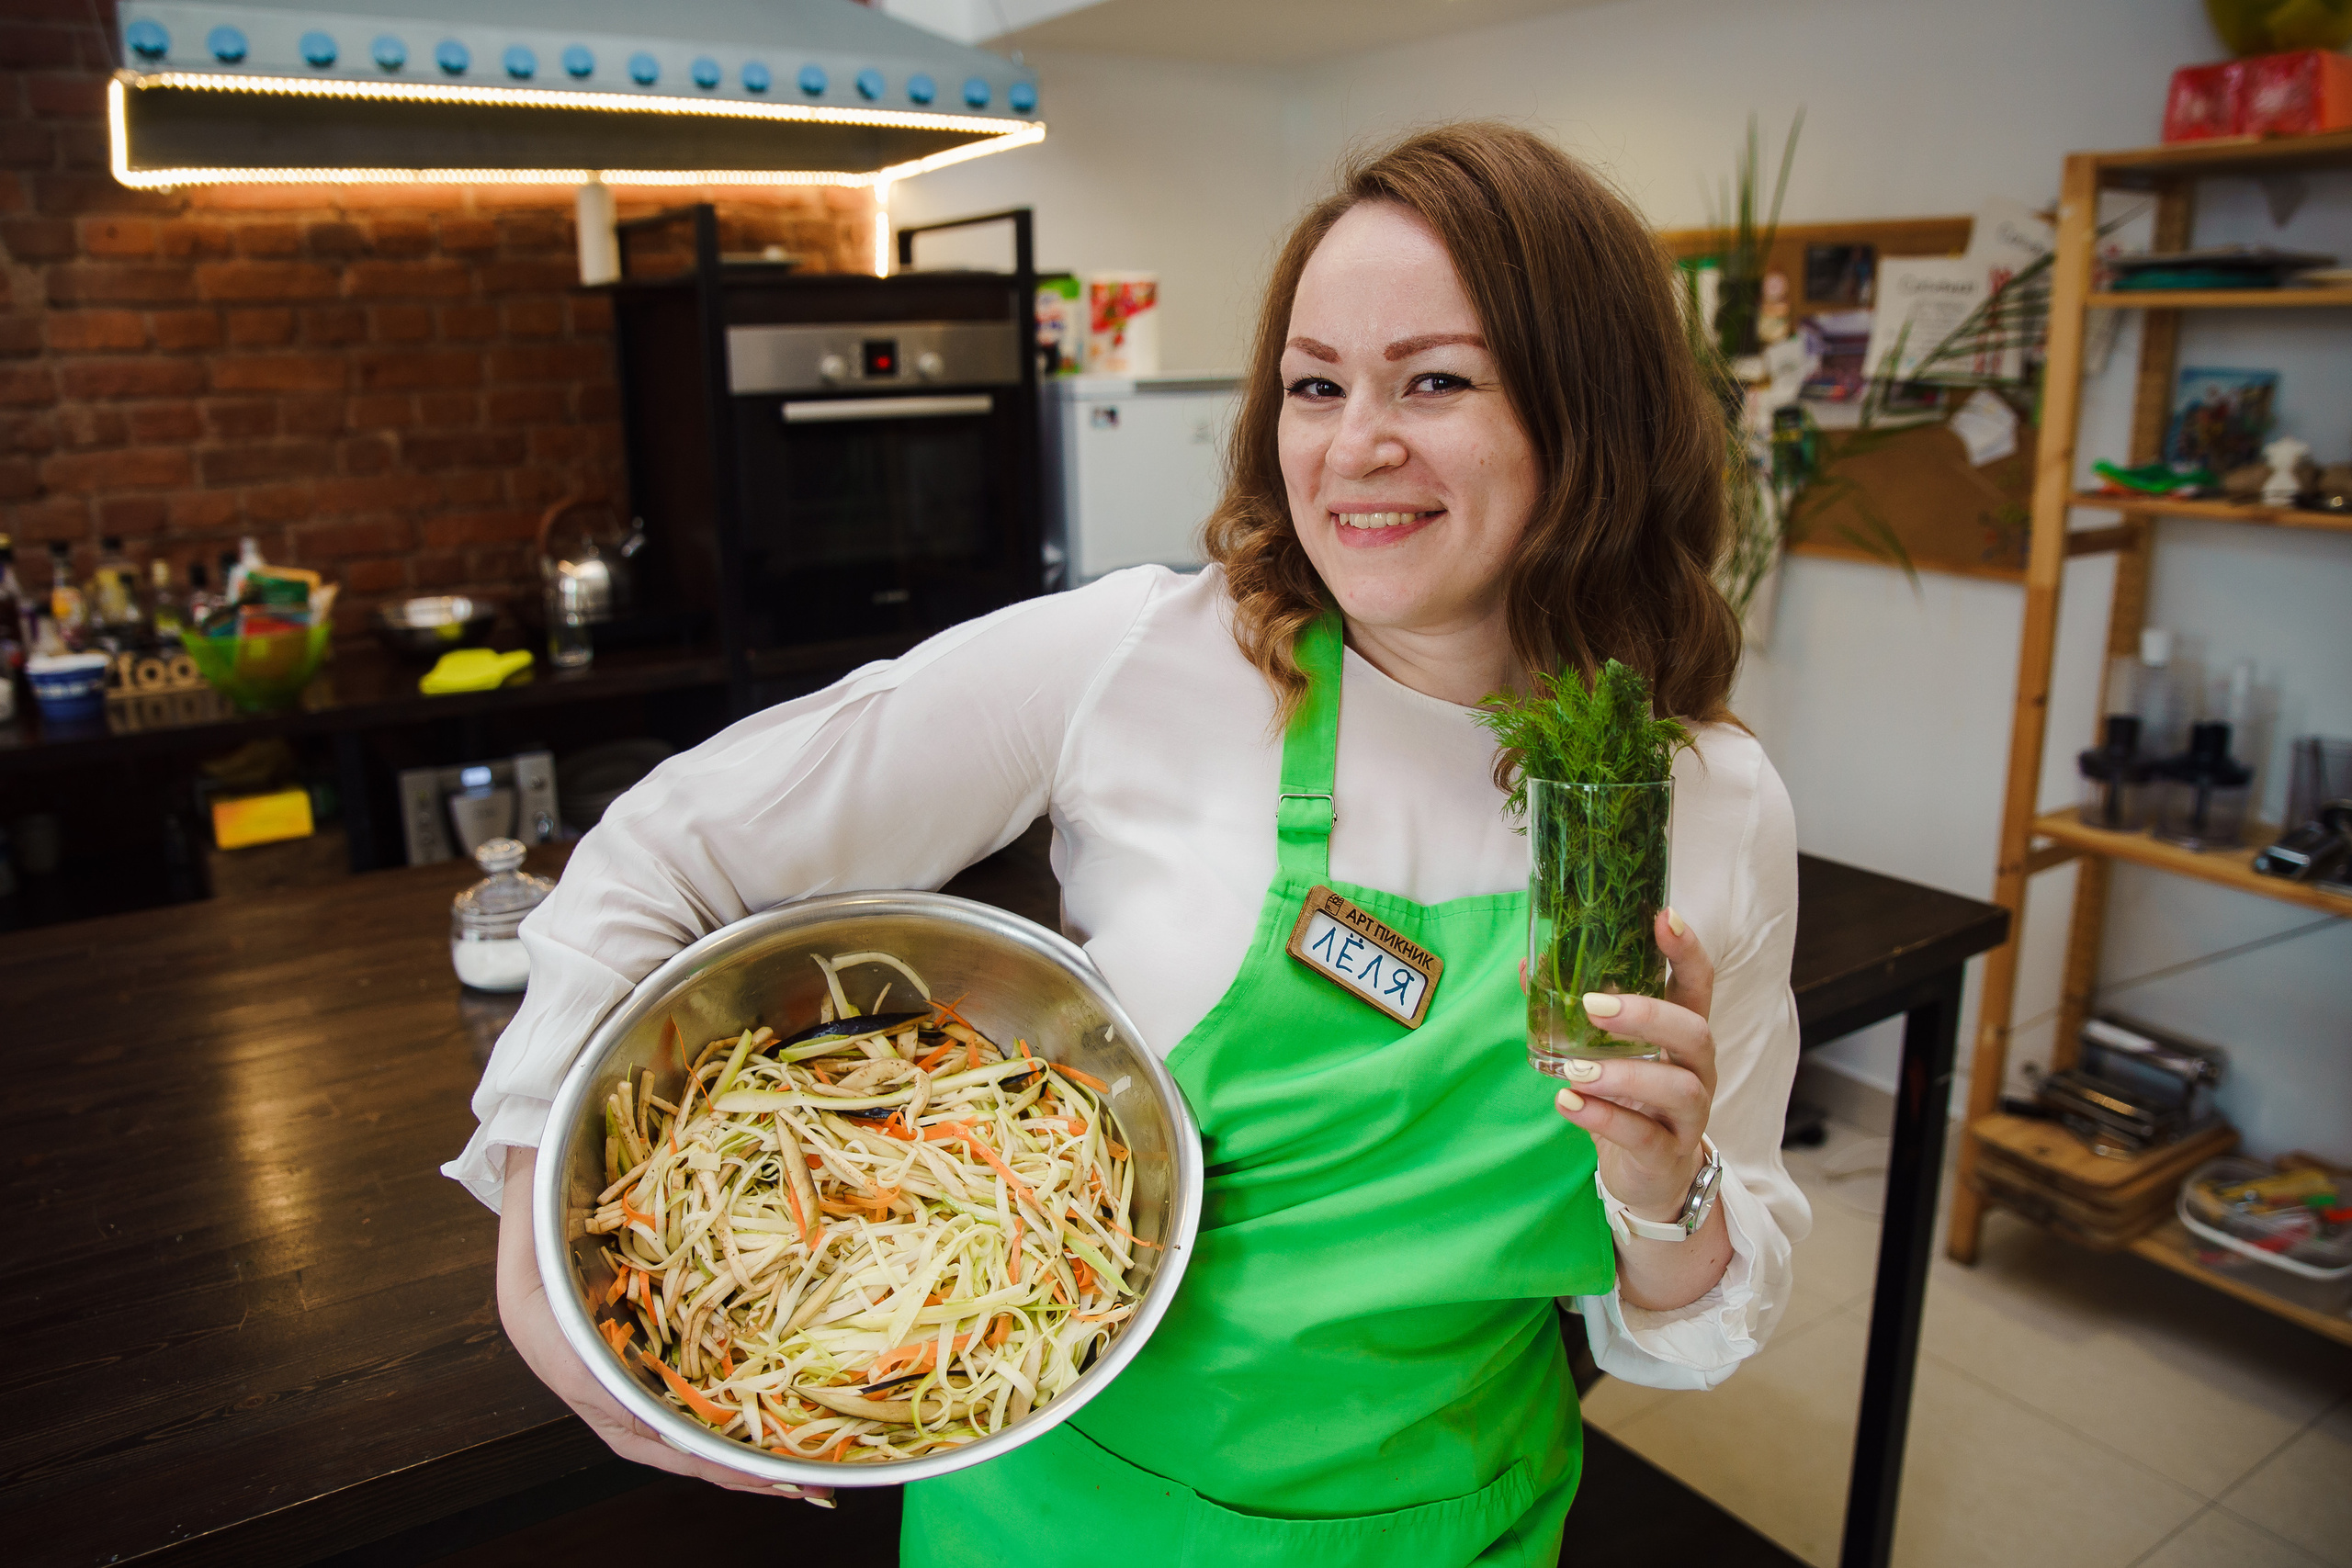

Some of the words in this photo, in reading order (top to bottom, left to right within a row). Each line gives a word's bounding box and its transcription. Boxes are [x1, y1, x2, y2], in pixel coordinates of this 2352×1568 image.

[1312, 926, 1415, 1006] ЛЁЛЯ
[1345, 908, 1374, 931] АРТ
[1373, 923, 1435, 971] ПИКНИК
